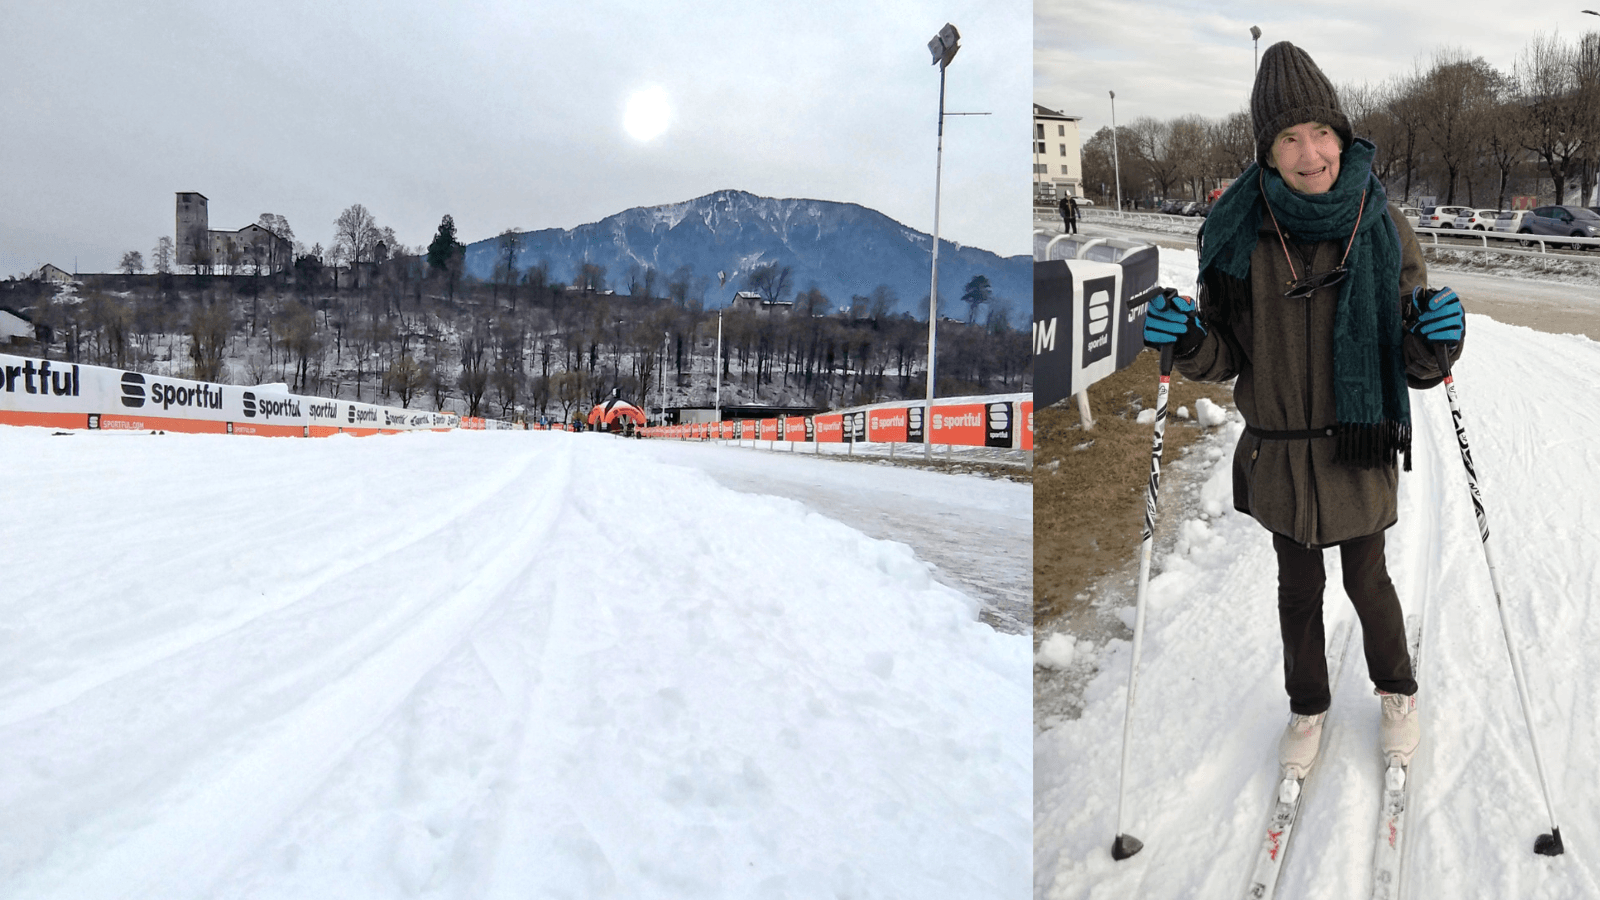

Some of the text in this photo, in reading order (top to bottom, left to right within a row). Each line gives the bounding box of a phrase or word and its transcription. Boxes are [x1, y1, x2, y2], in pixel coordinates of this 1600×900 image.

[1087, 333, 1108, 353] sportful
[152, 383, 222, 410] sportful
[259, 398, 301, 419] sportful
[309, 402, 337, 420] sportful
[103, 420, 144, 430] SPORTFUL.COM
[879, 415, 905, 428] sportful
[944, 413, 982, 429] sportful
